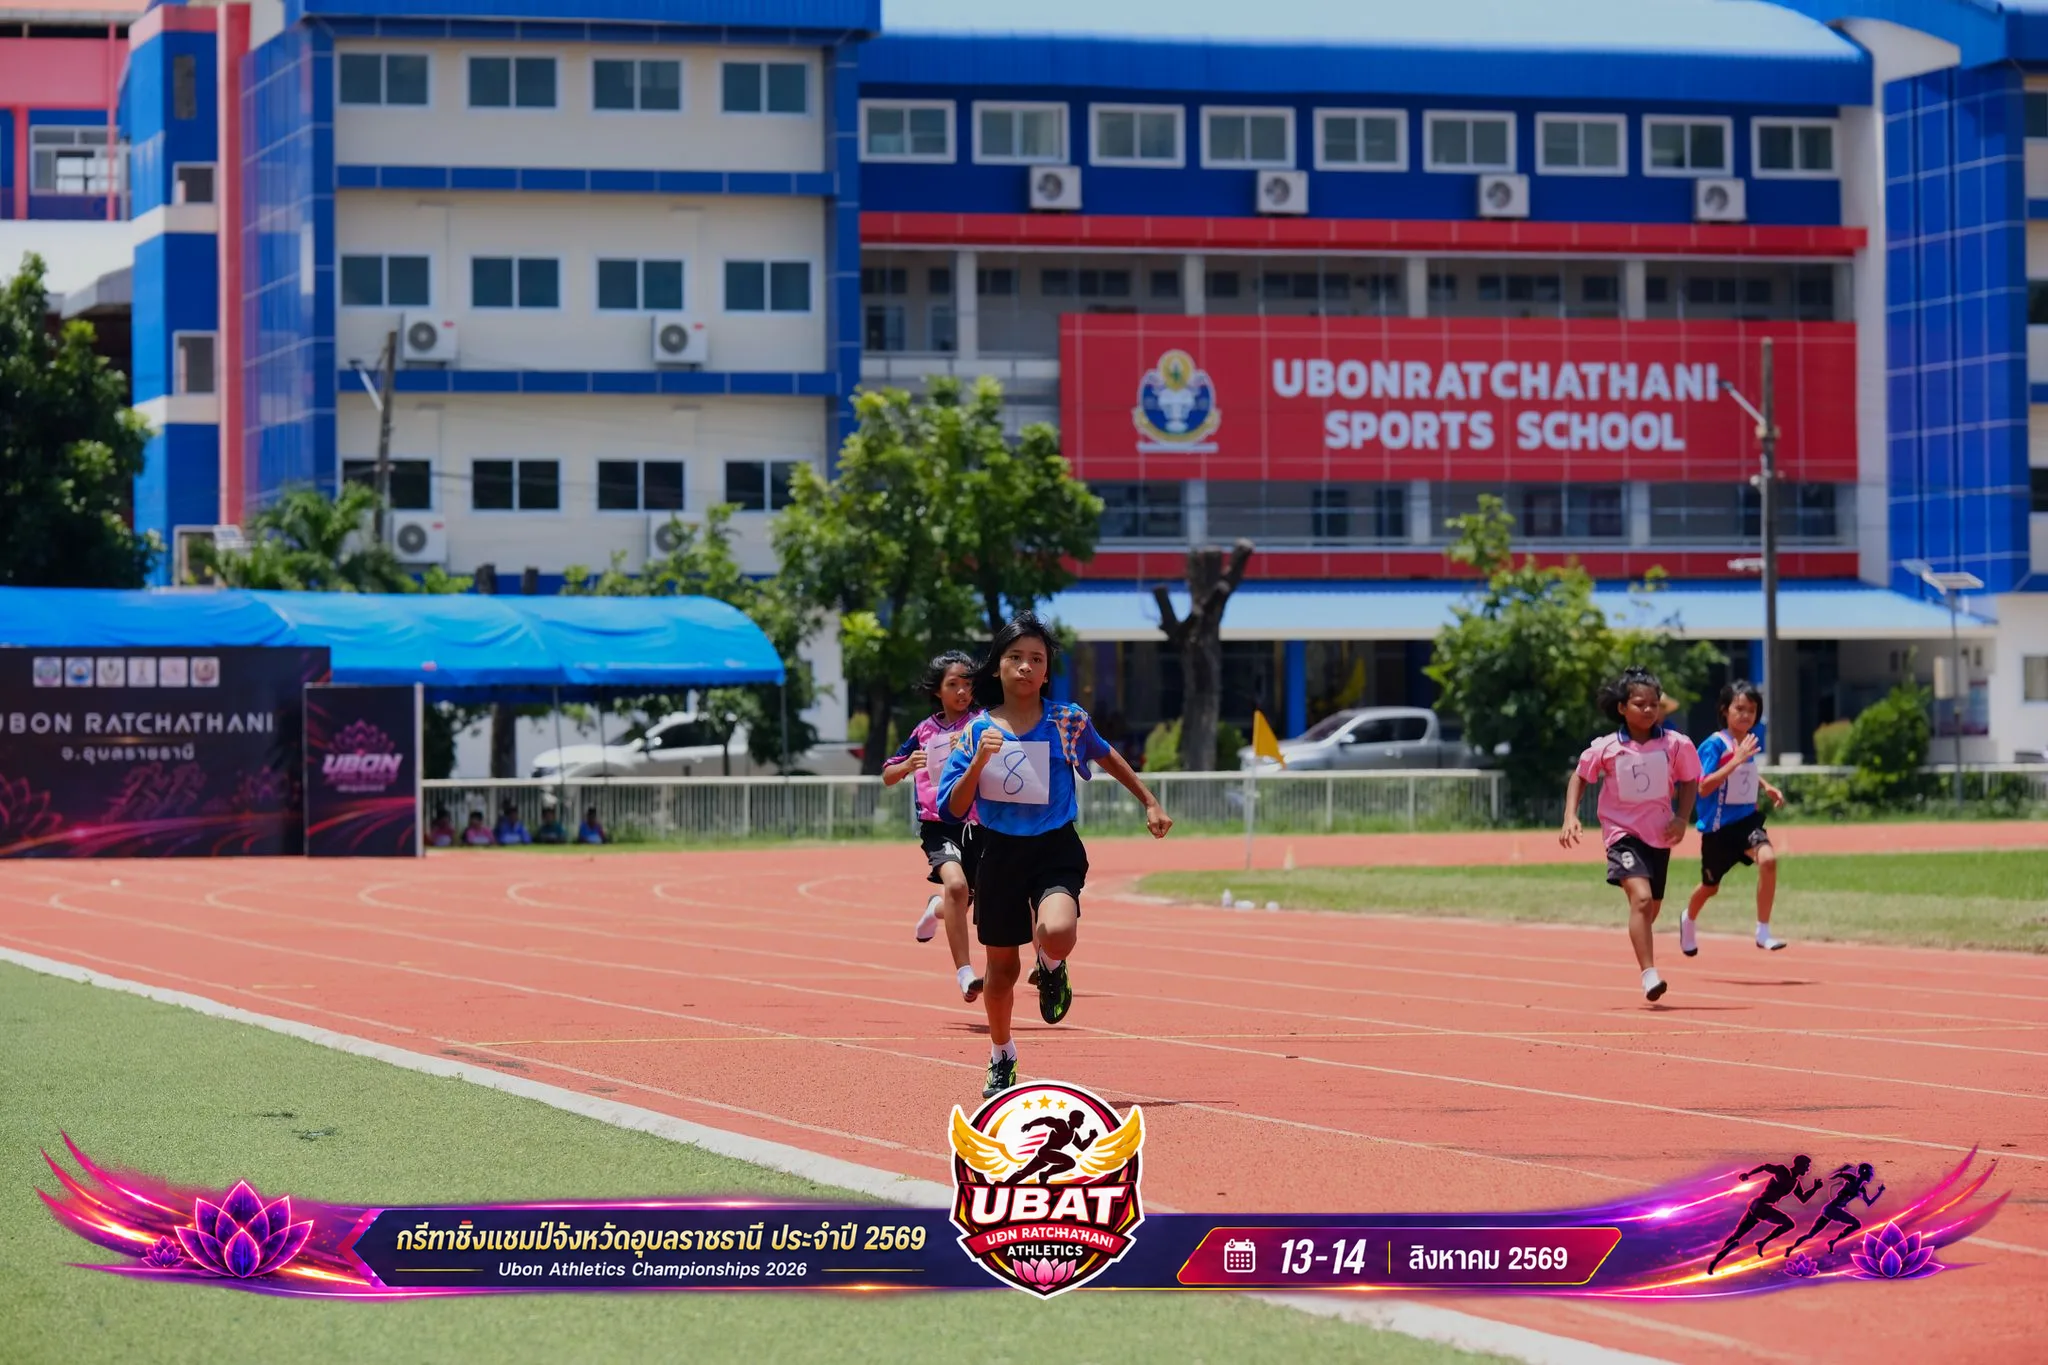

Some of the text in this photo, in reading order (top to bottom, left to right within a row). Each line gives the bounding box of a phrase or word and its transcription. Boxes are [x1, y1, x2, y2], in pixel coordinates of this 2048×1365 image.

[1272, 358, 1719, 402] UBONRATCHATHANI
[1325, 409, 1686, 451] SPORTS SCHOOL
[0, 712, 273, 734] BON RATCHATHANI
[322, 753, 403, 774] UBON
[1003, 750, 1026, 795] 8
[1632, 763, 1650, 793] 5
[1739, 770, 1752, 796] 3
